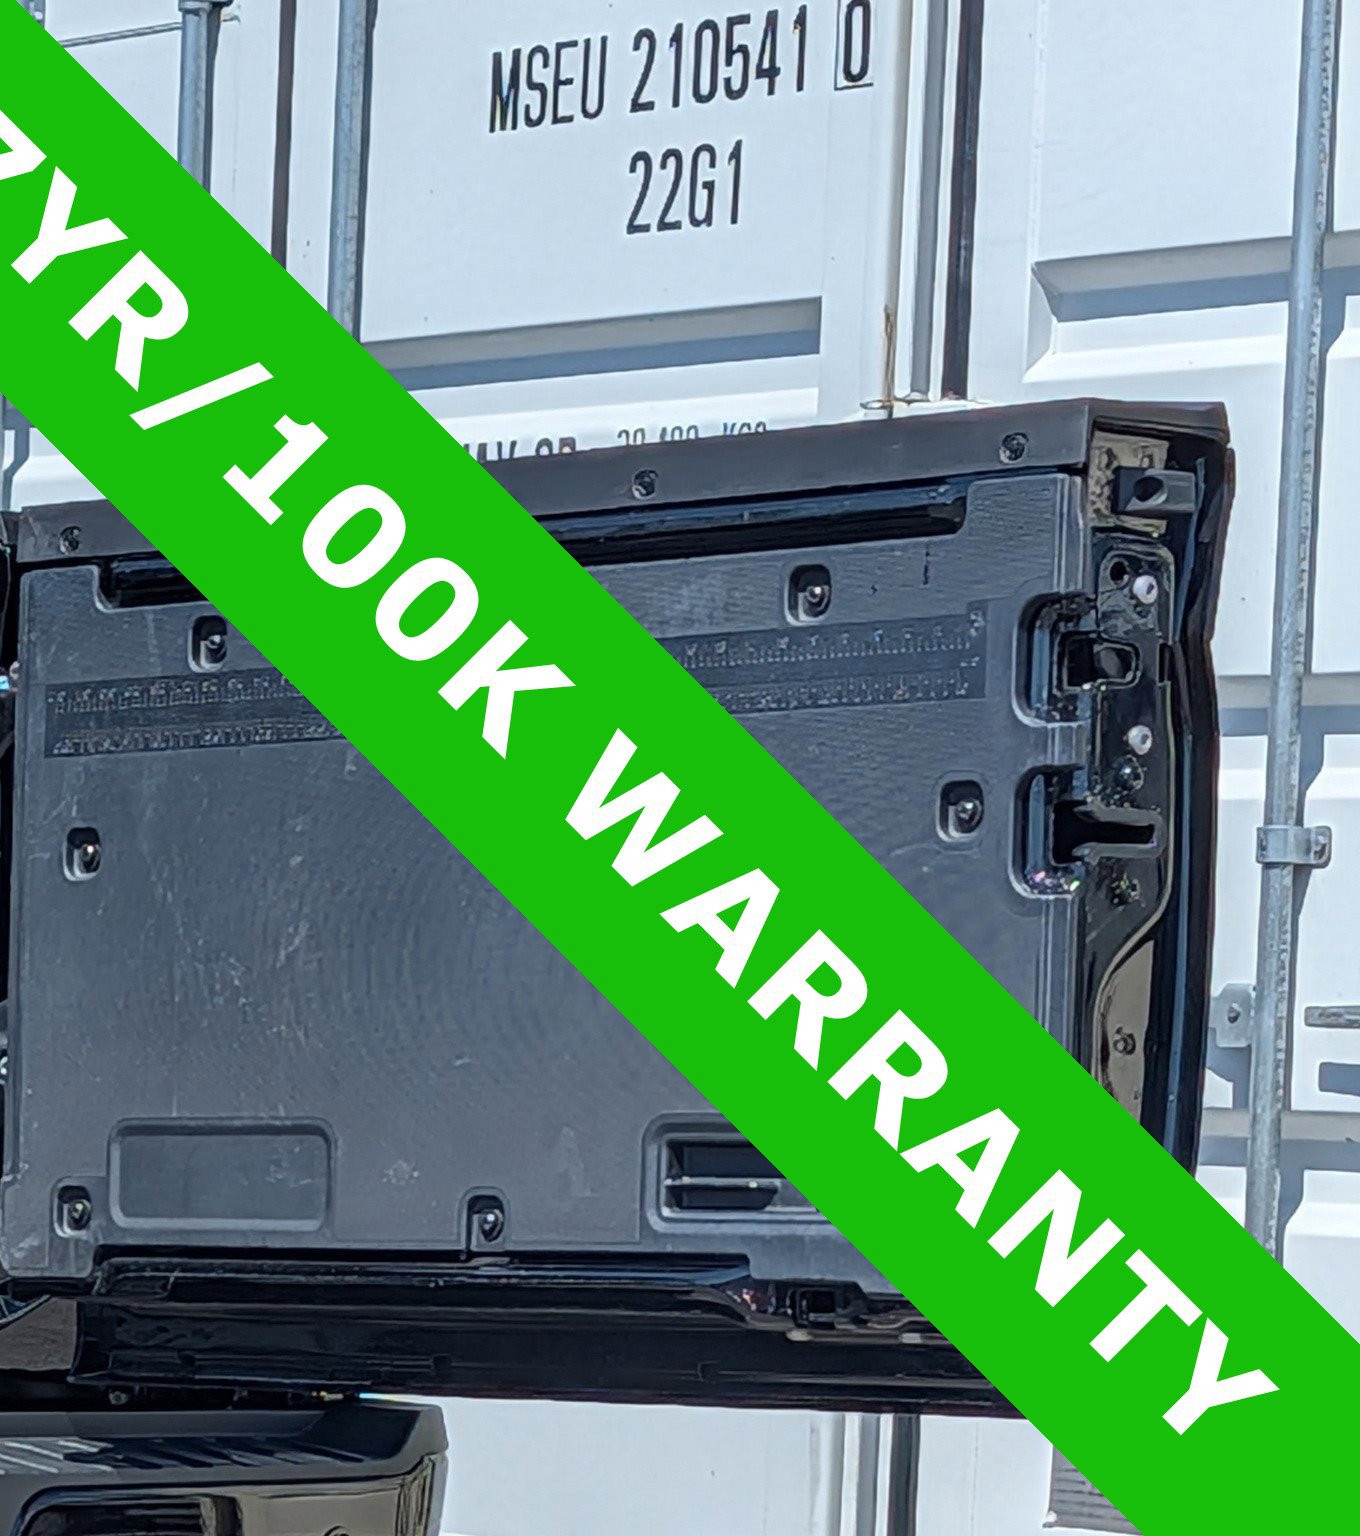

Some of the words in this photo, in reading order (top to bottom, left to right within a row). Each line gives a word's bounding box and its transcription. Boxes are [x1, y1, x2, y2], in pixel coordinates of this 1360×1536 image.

[489, 36, 608, 133] MSEU
[630, 4, 807, 113] 210541
[843, 0, 871, 82] 0
[627, 140, 743, 234] 22G1
